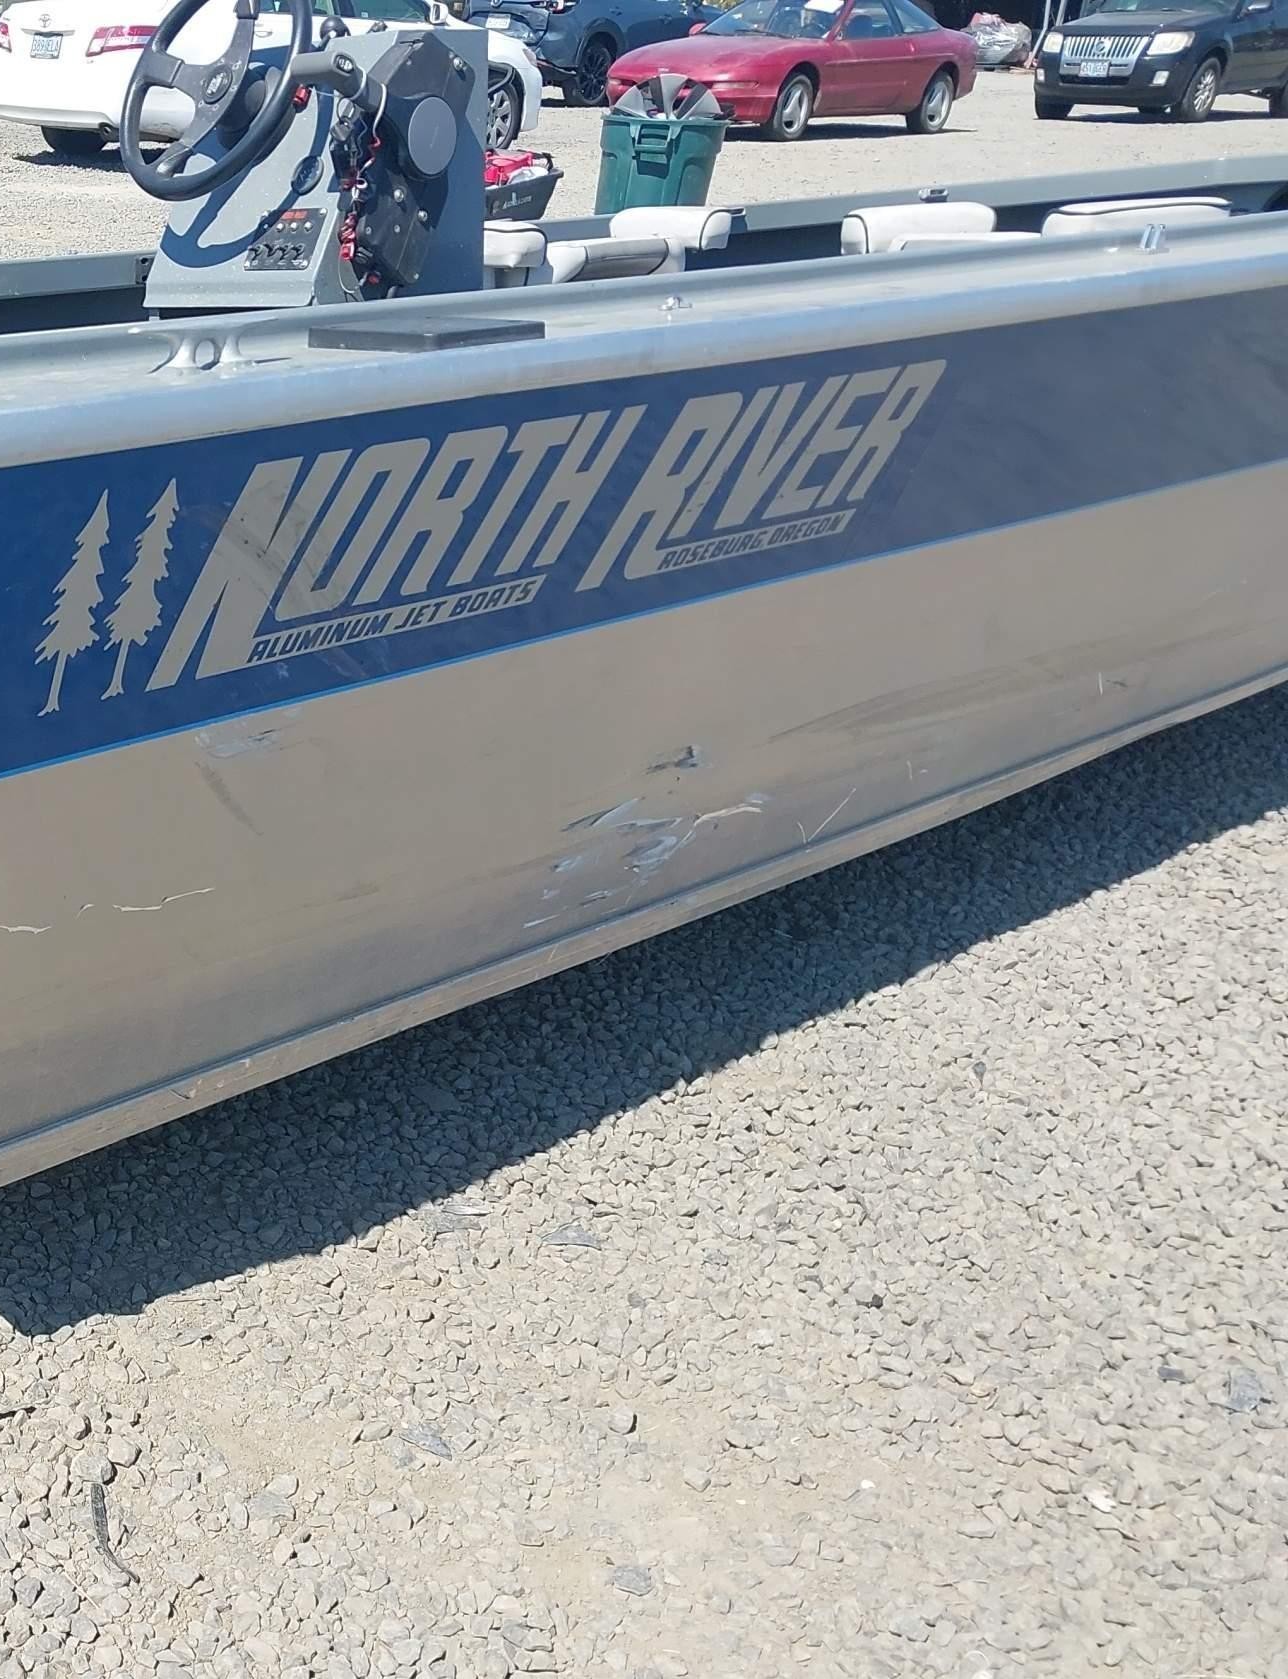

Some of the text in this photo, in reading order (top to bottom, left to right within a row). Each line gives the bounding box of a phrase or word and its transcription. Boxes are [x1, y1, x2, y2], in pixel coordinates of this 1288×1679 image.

[145, 359, 947, 692] NORTH RIVER
[768, 513, 846, 545] OREGON
[246, 580, 537, 663] ALUMINUM JET BOATS
